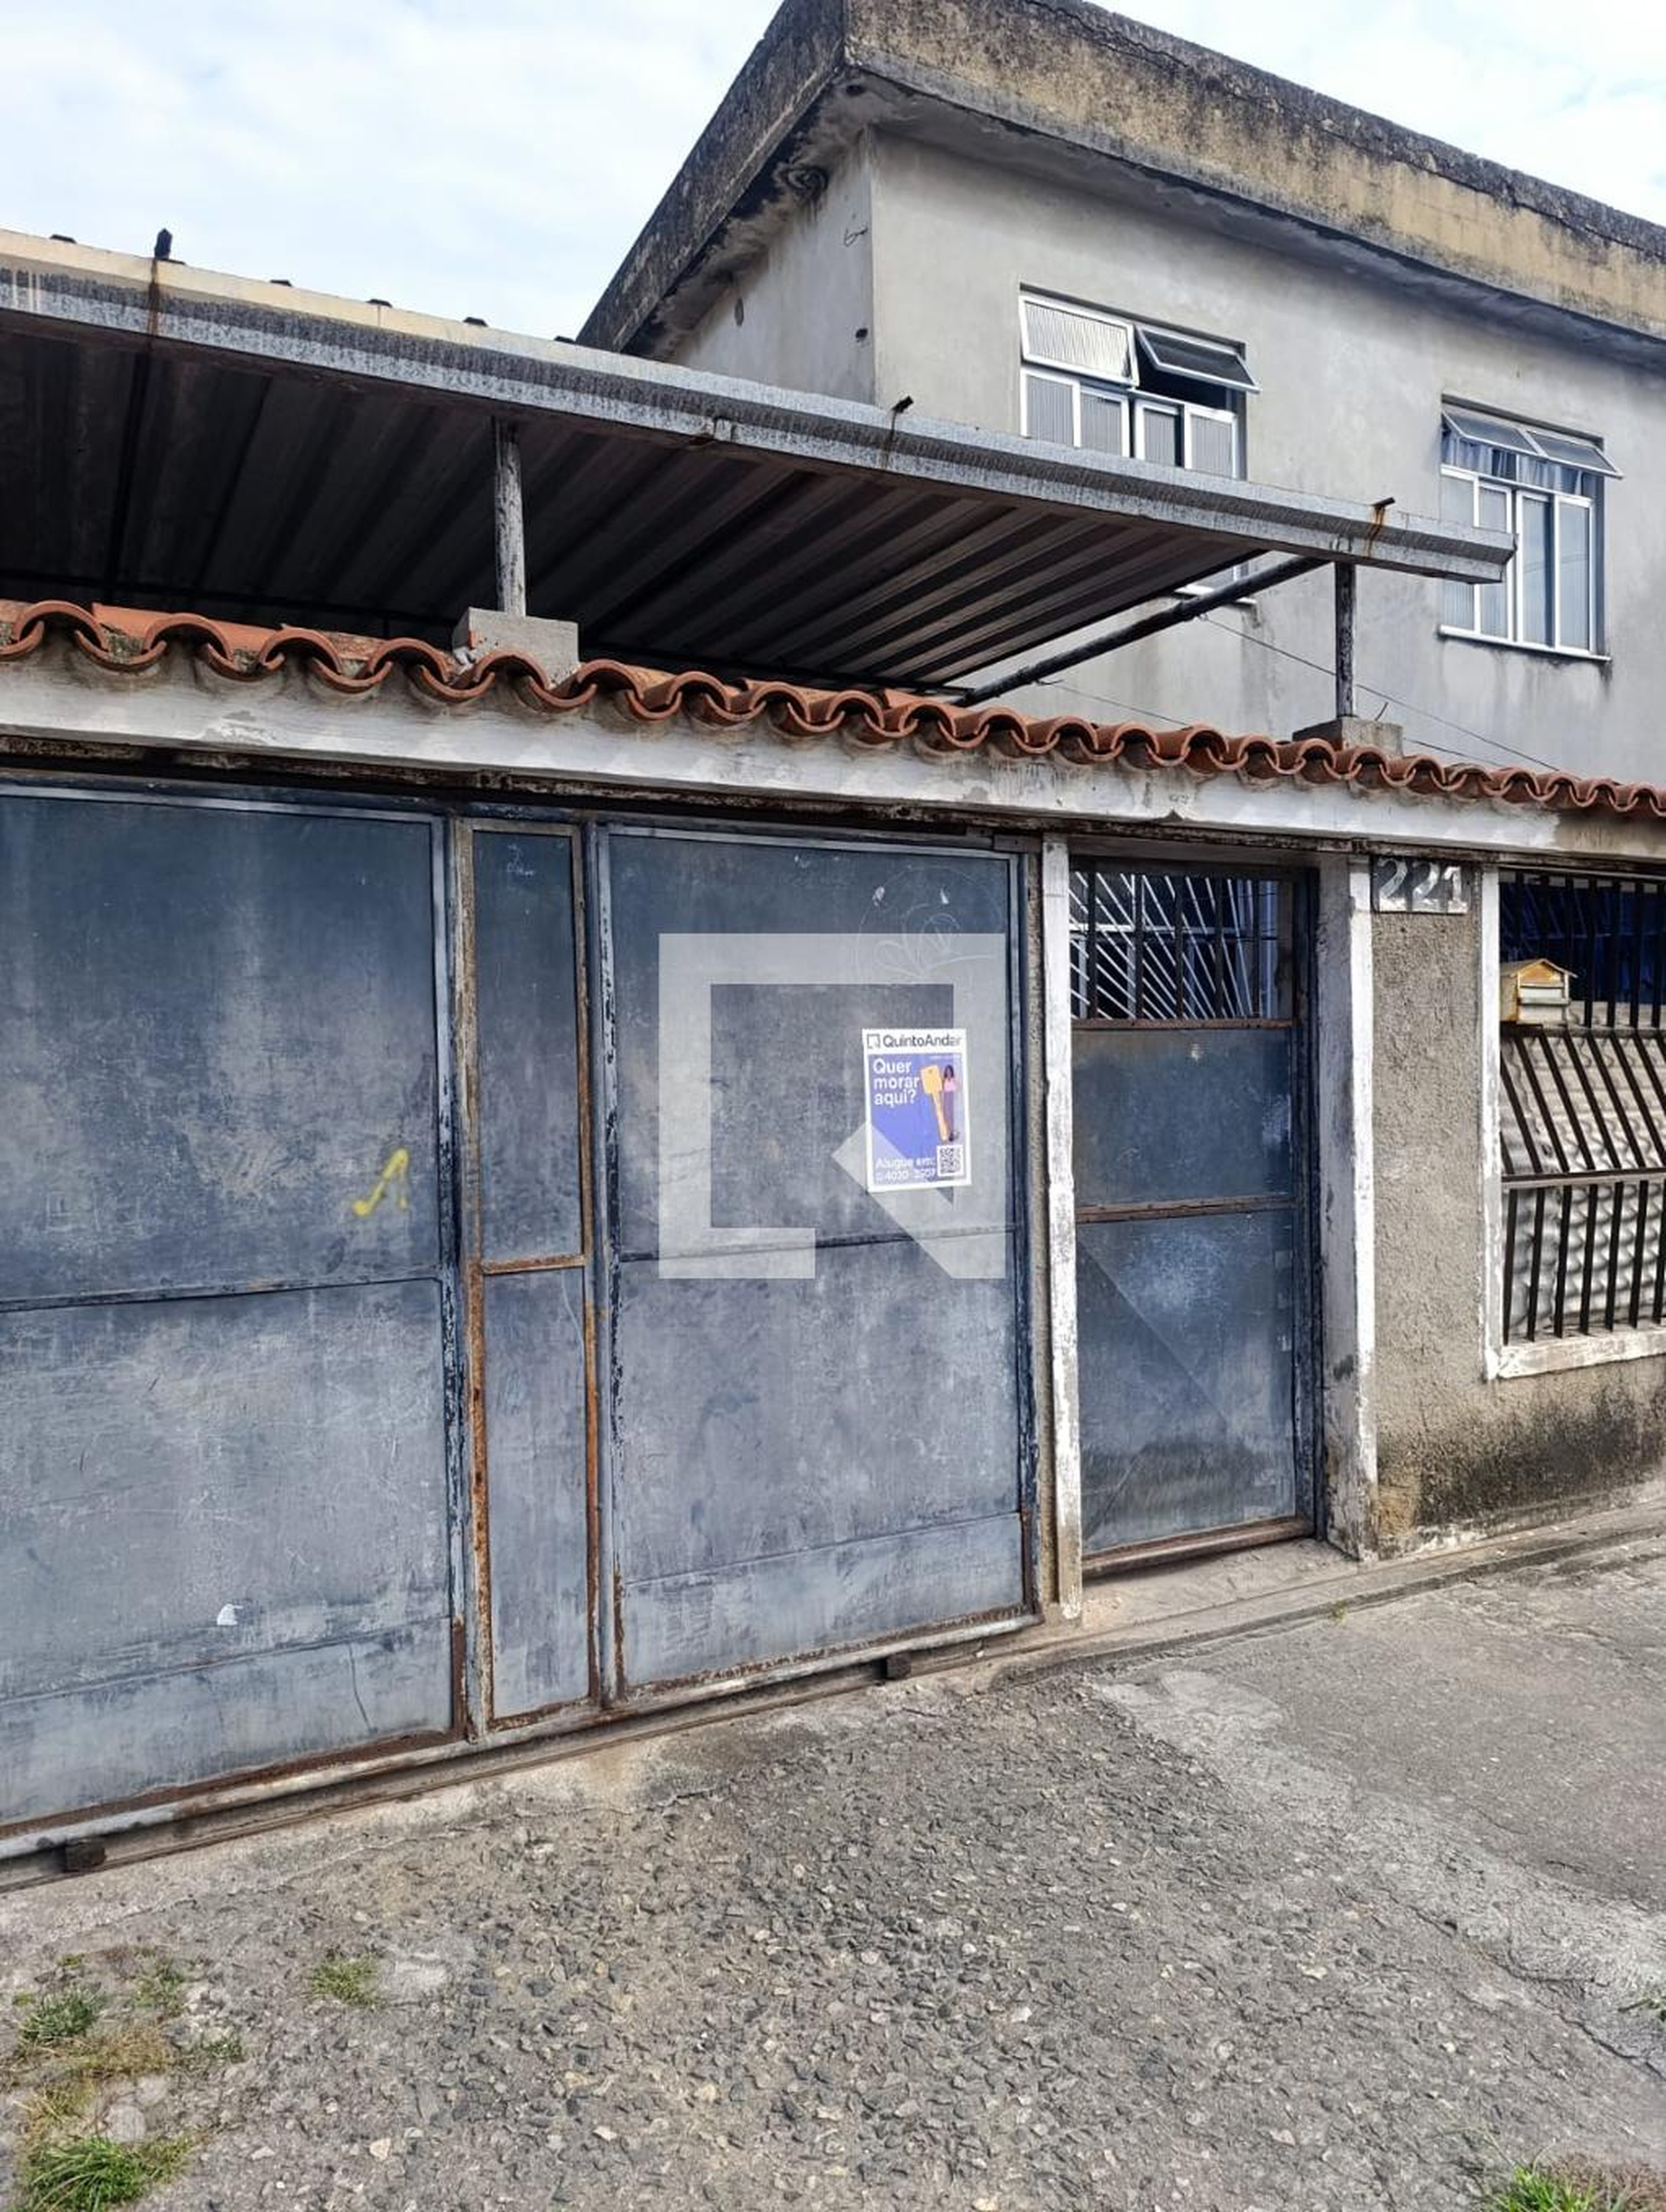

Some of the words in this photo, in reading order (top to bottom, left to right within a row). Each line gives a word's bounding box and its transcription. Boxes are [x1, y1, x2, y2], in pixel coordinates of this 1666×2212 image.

[1378, 858, 1467, 913] 221
[882, 1034, 961, 1048] QuintoAndar
[873, 1058, 912, 1074] Quer
[874, 1077, 919, 1090] morar
[874, 1089, 916, 1108] aqui?
